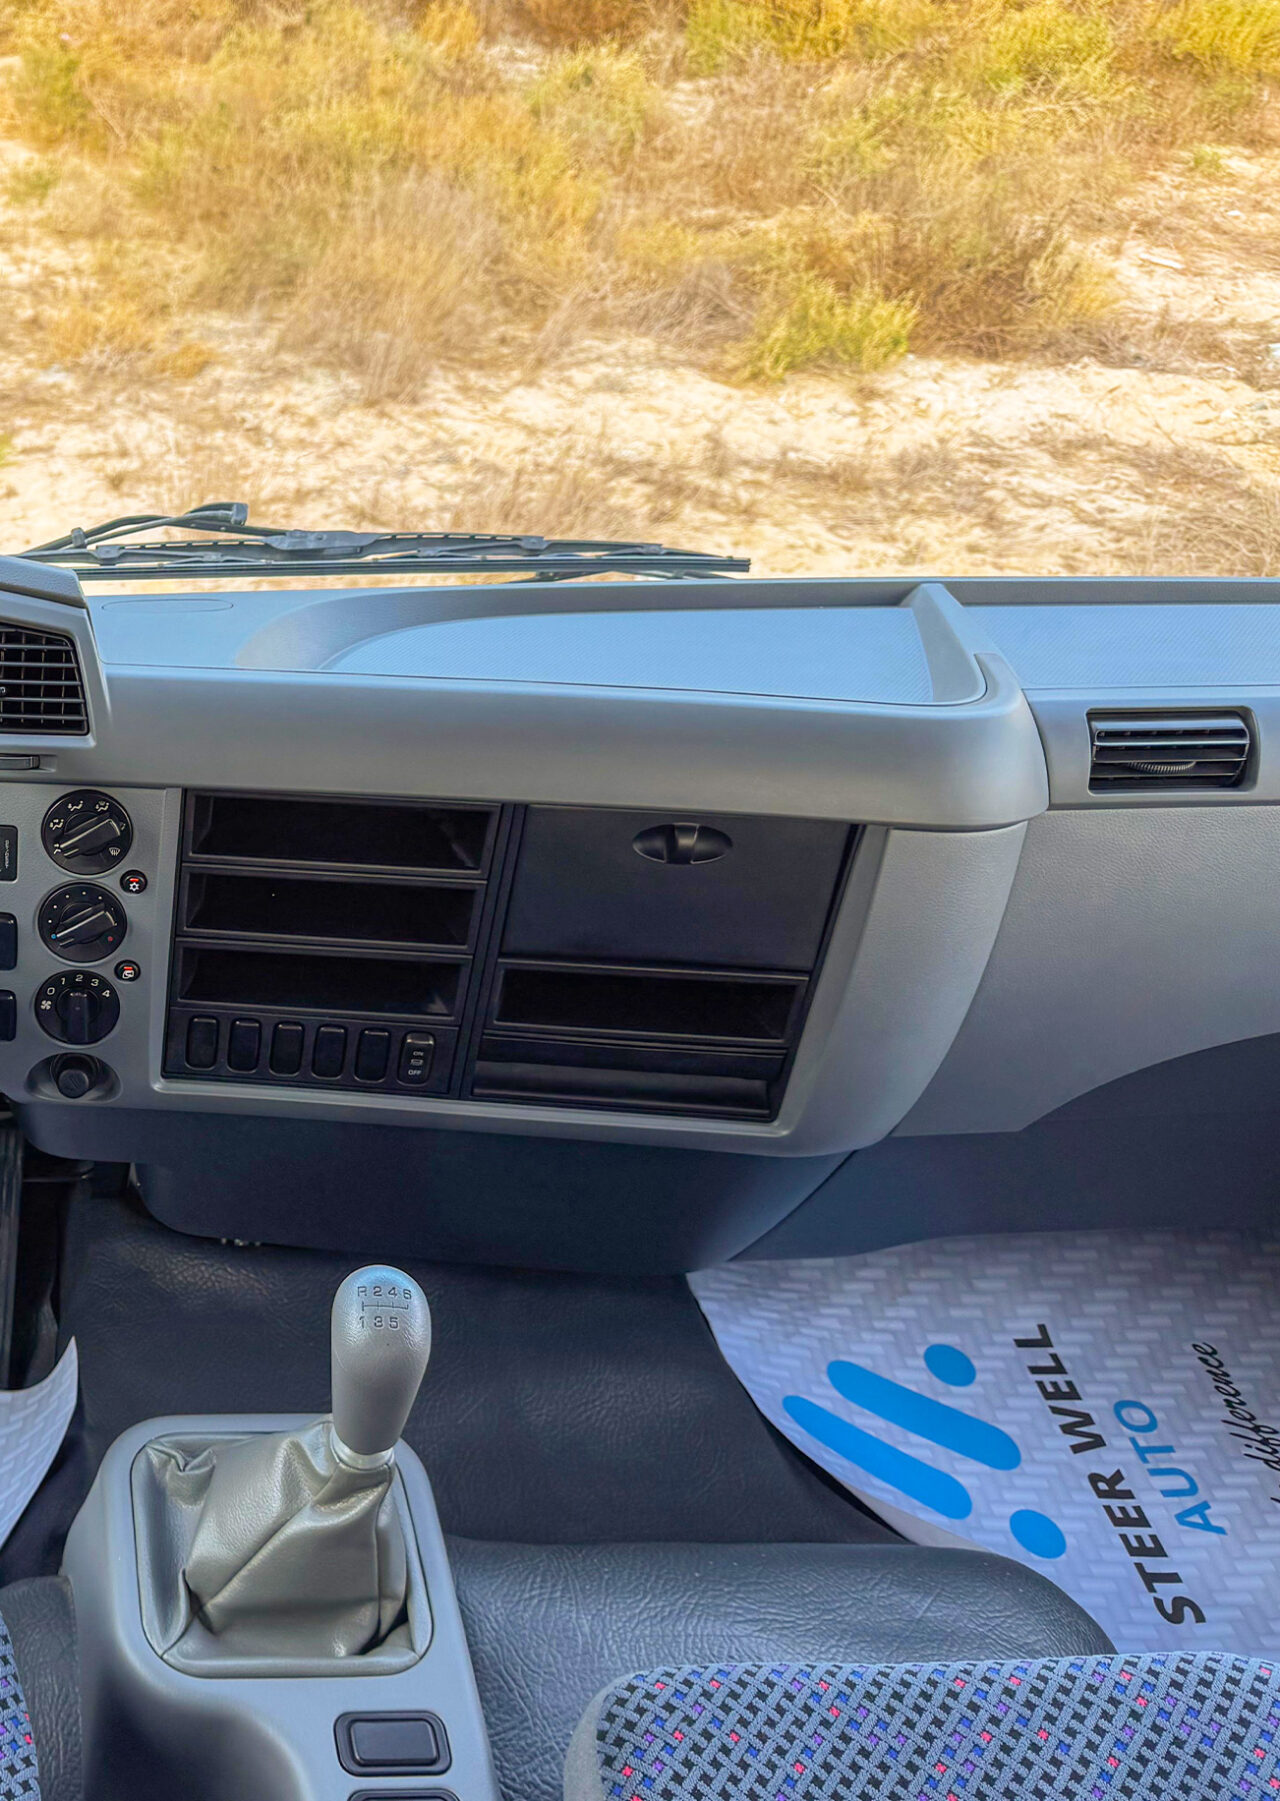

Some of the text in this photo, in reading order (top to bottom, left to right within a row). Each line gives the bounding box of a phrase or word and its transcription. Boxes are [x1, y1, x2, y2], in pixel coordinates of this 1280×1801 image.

[60, 977, 66, 985] 1
[75, 974, 84, 982] 2
[90, 978, 99, 987] 3
[46, 987, 56, 996] 0
[102, 989, 111, 998] 4
[357, 1286, 412, 1300] R 2 4 6
[374, 1315, 383, 1328] 3
[389, 1316, 399, 1329] 5
[1113, 1400, 1228, 1536] AUTO
[1013, 1323, 1207, 1625] STEER WELL
